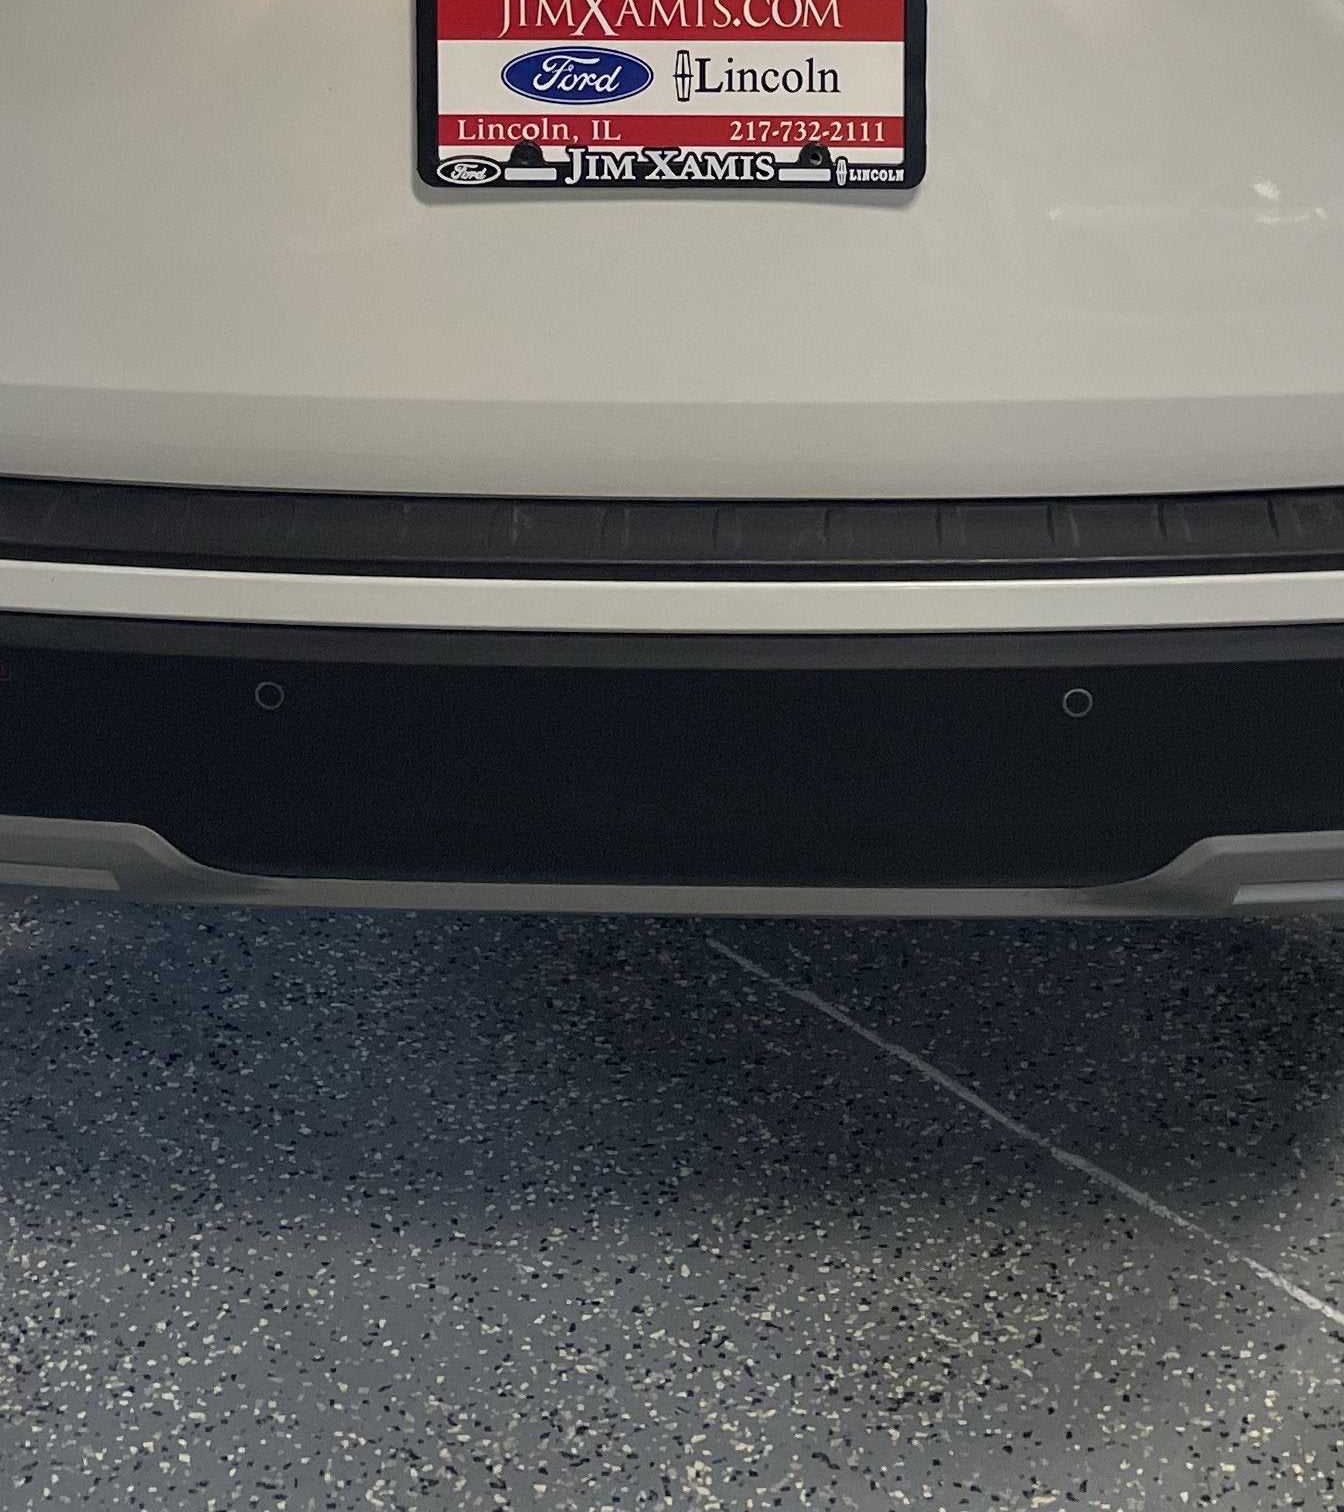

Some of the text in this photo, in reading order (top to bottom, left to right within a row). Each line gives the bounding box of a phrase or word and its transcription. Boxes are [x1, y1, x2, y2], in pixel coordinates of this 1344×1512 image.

[532, 55, 622, 94] Ford
[695, 57, 841, 93] Lincoln
[457, 119, 621, 143] Lincoln, IL
[730, 120, 884, 142] 217-732-2111
[451, 164, 486, 180] Ford
[849, 170, 904, 182] LINCOLN
